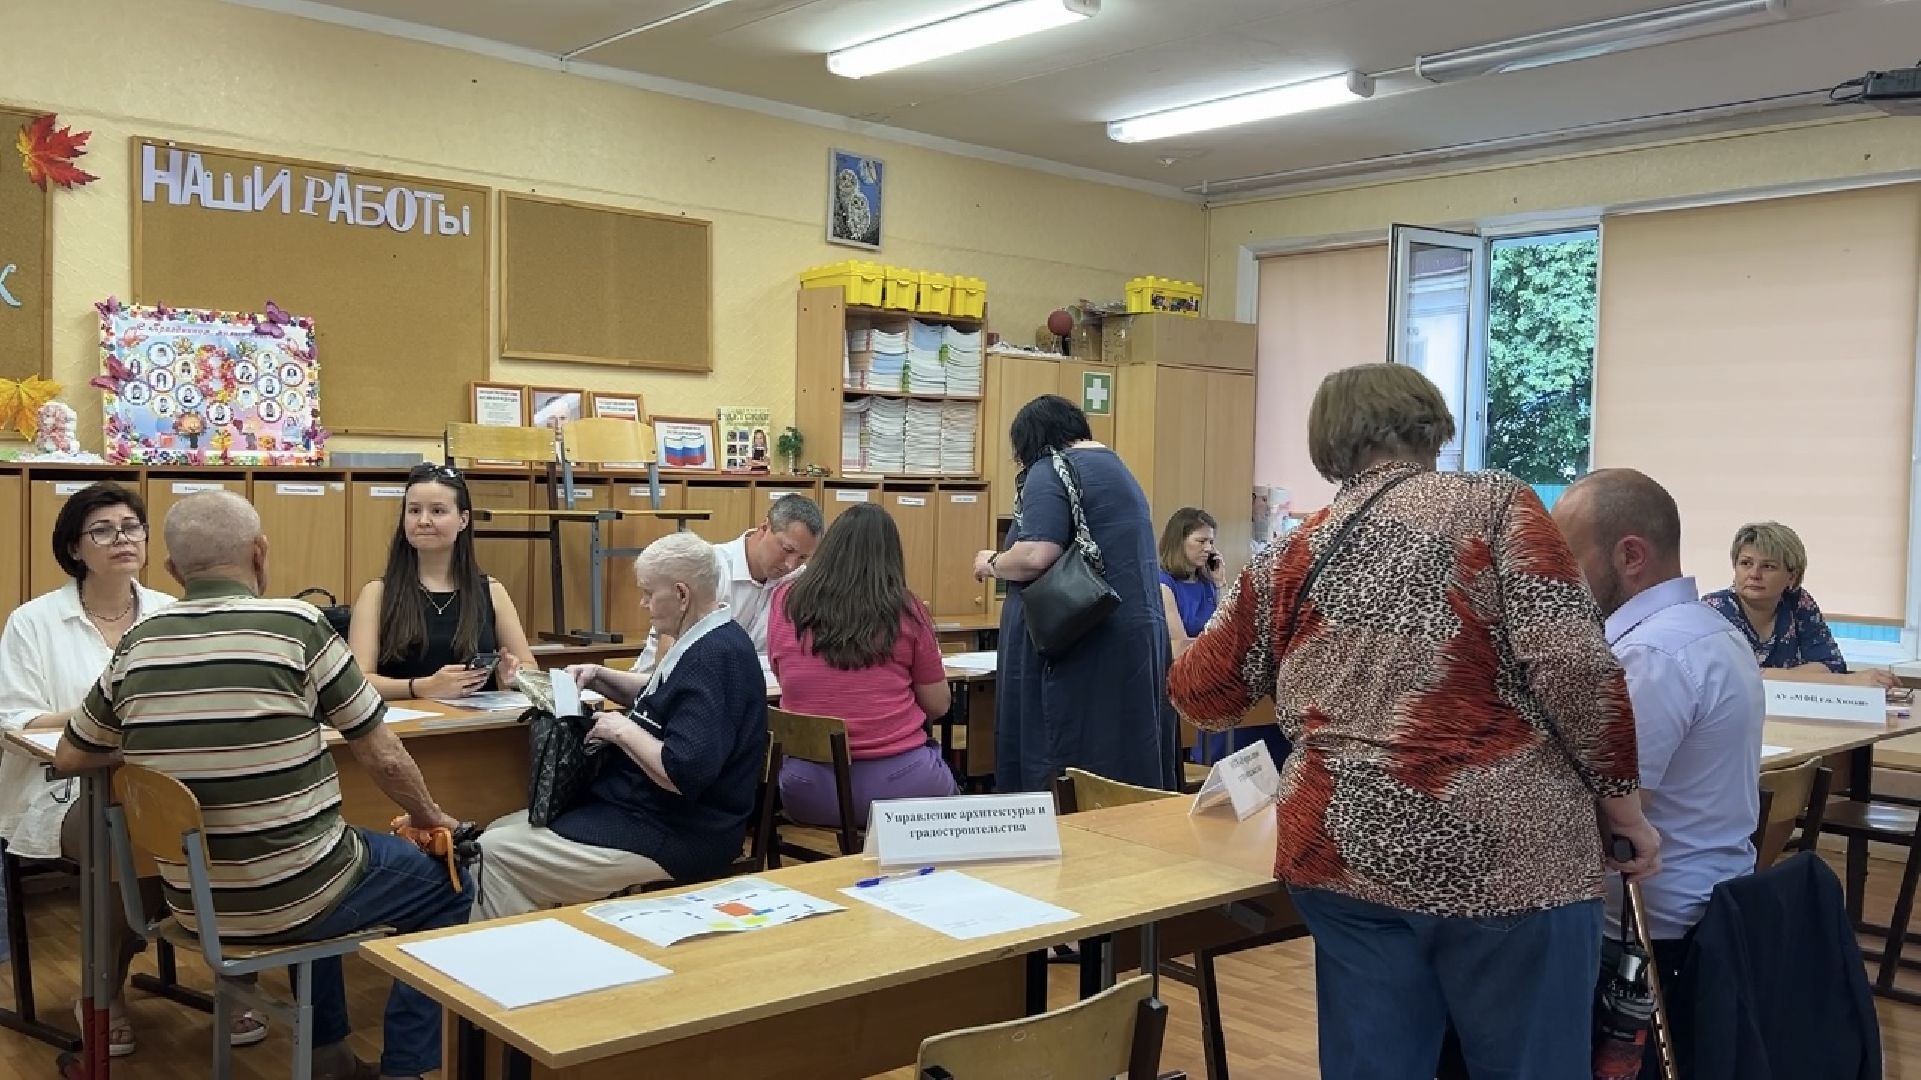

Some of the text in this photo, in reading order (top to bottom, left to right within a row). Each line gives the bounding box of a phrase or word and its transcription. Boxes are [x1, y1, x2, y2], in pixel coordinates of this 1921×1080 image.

[142, 145, 469, 236] НАШИ РАБОТЫ
[884, 805, 1046, 823] Управление архитектуры и
[910, 822, 1027, 840] градостроительства
